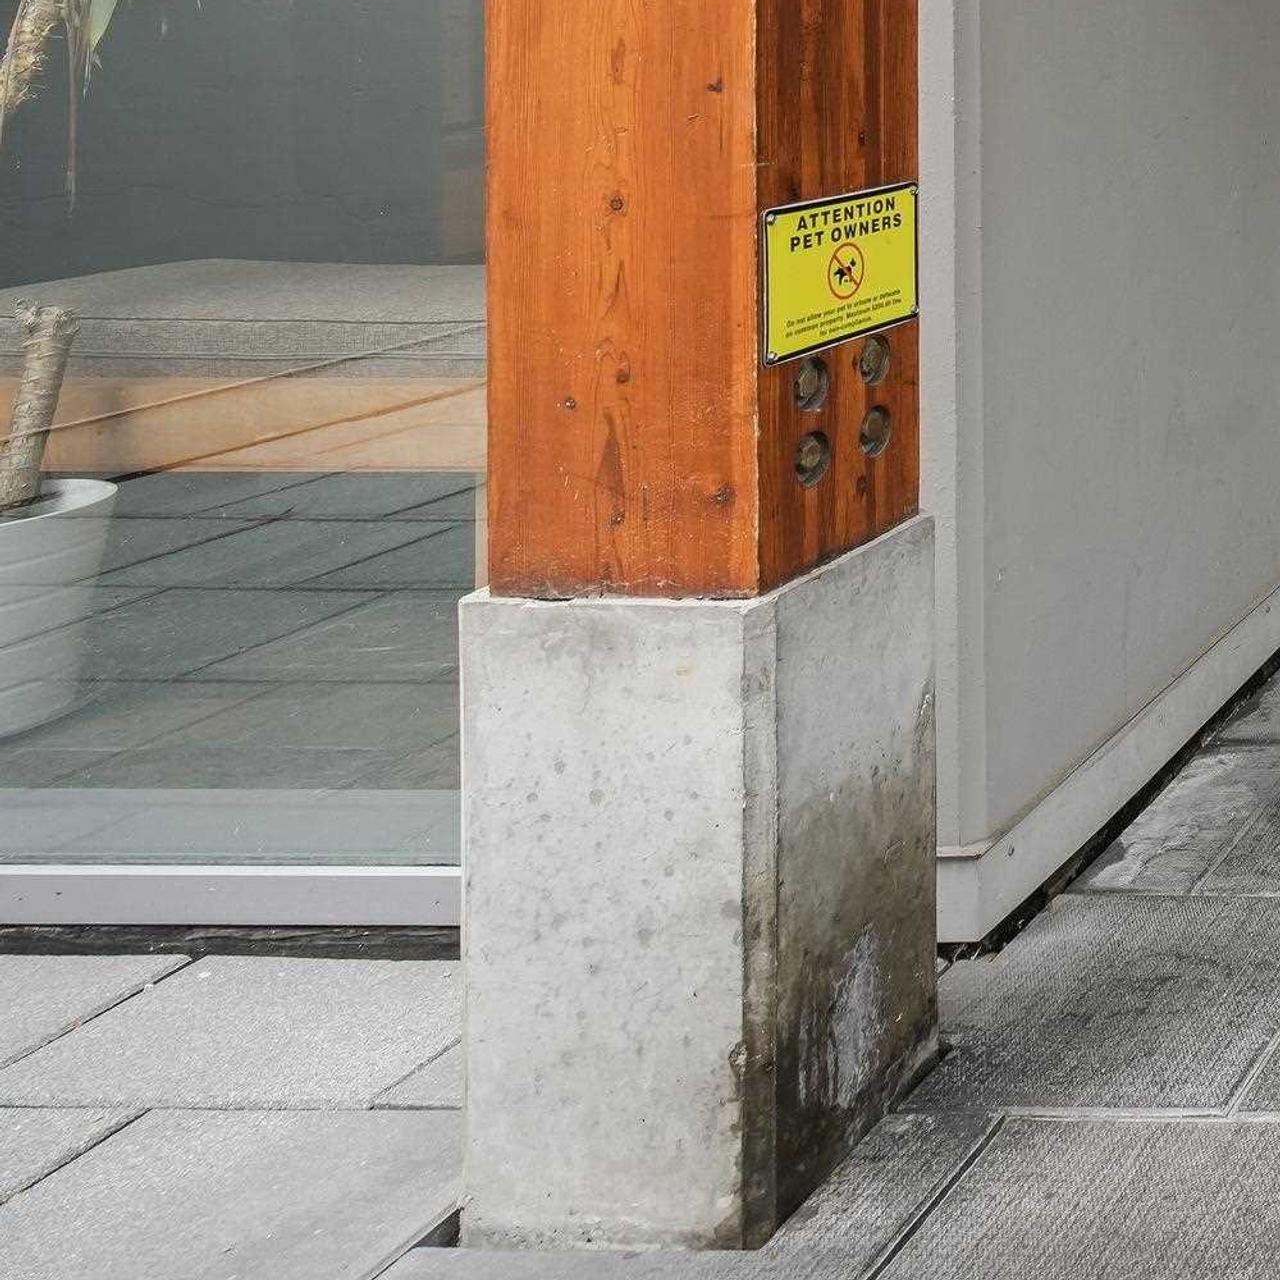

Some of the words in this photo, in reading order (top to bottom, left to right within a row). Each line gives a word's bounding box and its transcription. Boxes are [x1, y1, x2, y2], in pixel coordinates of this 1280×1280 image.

[797, 197, 896, 231] ATTENTION
[790, 231, 824, 252] PET
[831, 213, 902, 243] OWNERS
